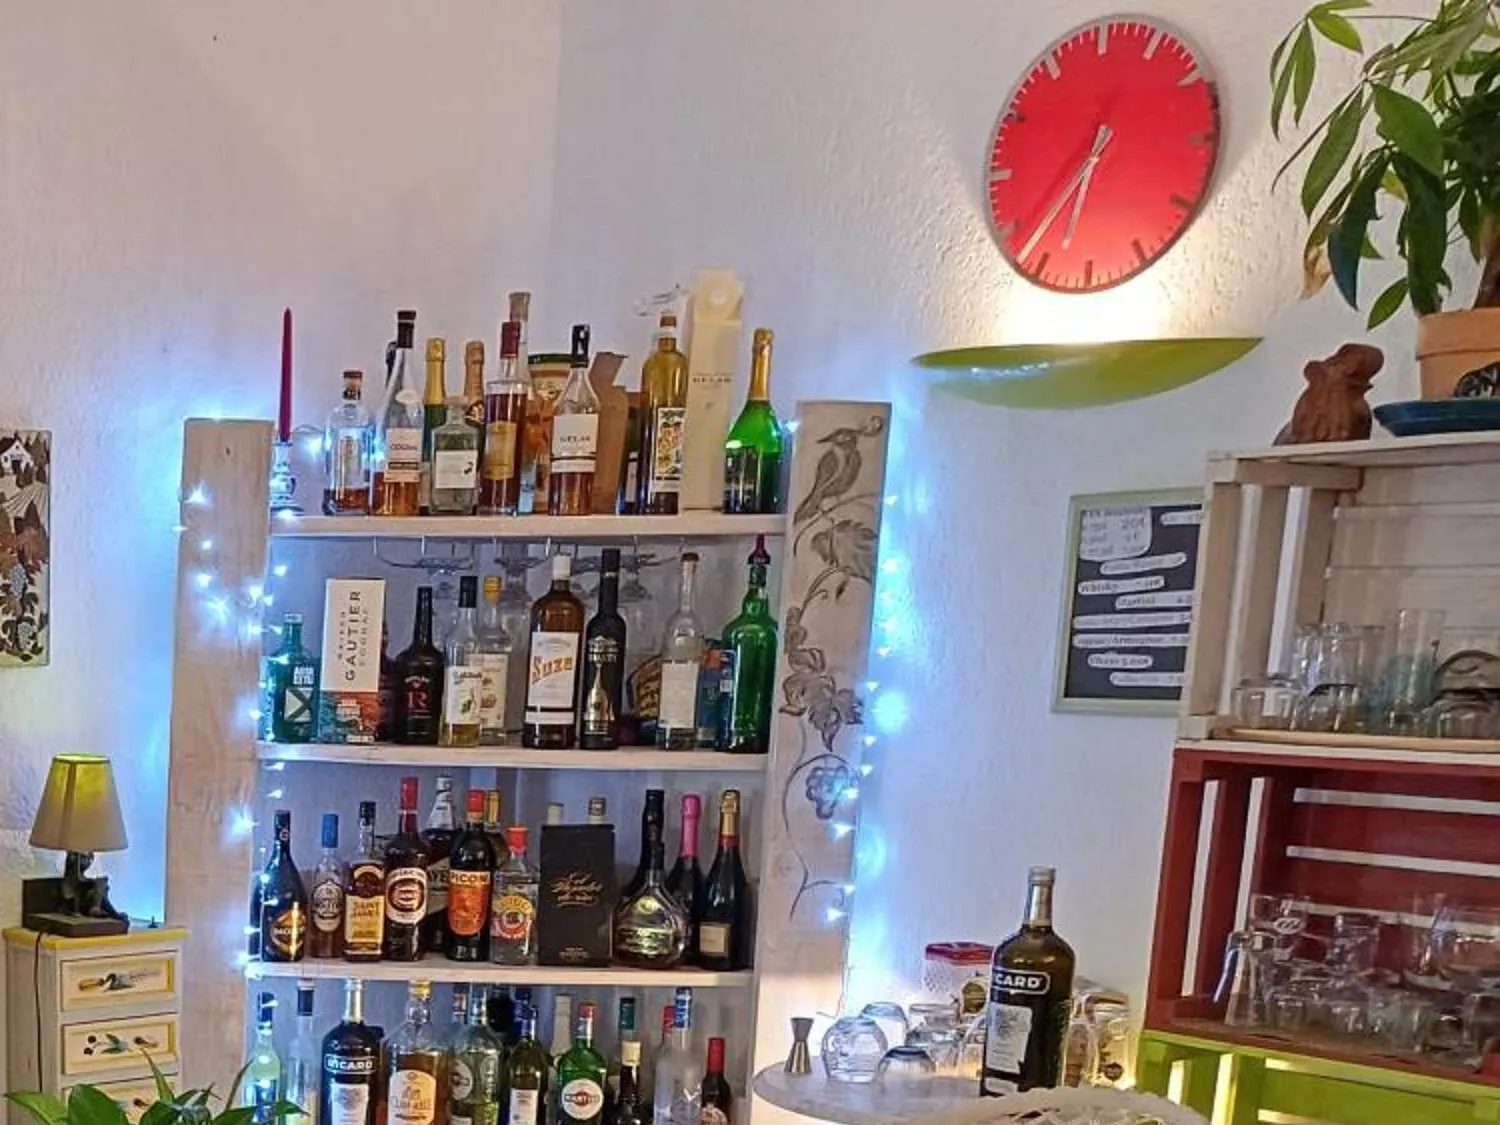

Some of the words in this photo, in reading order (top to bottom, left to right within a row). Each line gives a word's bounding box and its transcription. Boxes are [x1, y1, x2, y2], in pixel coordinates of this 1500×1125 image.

[344, 591, 361, 681] GAUTIER
[450, 872, 488, 882] PICON
[995, 973, 1041, 988] CARD
